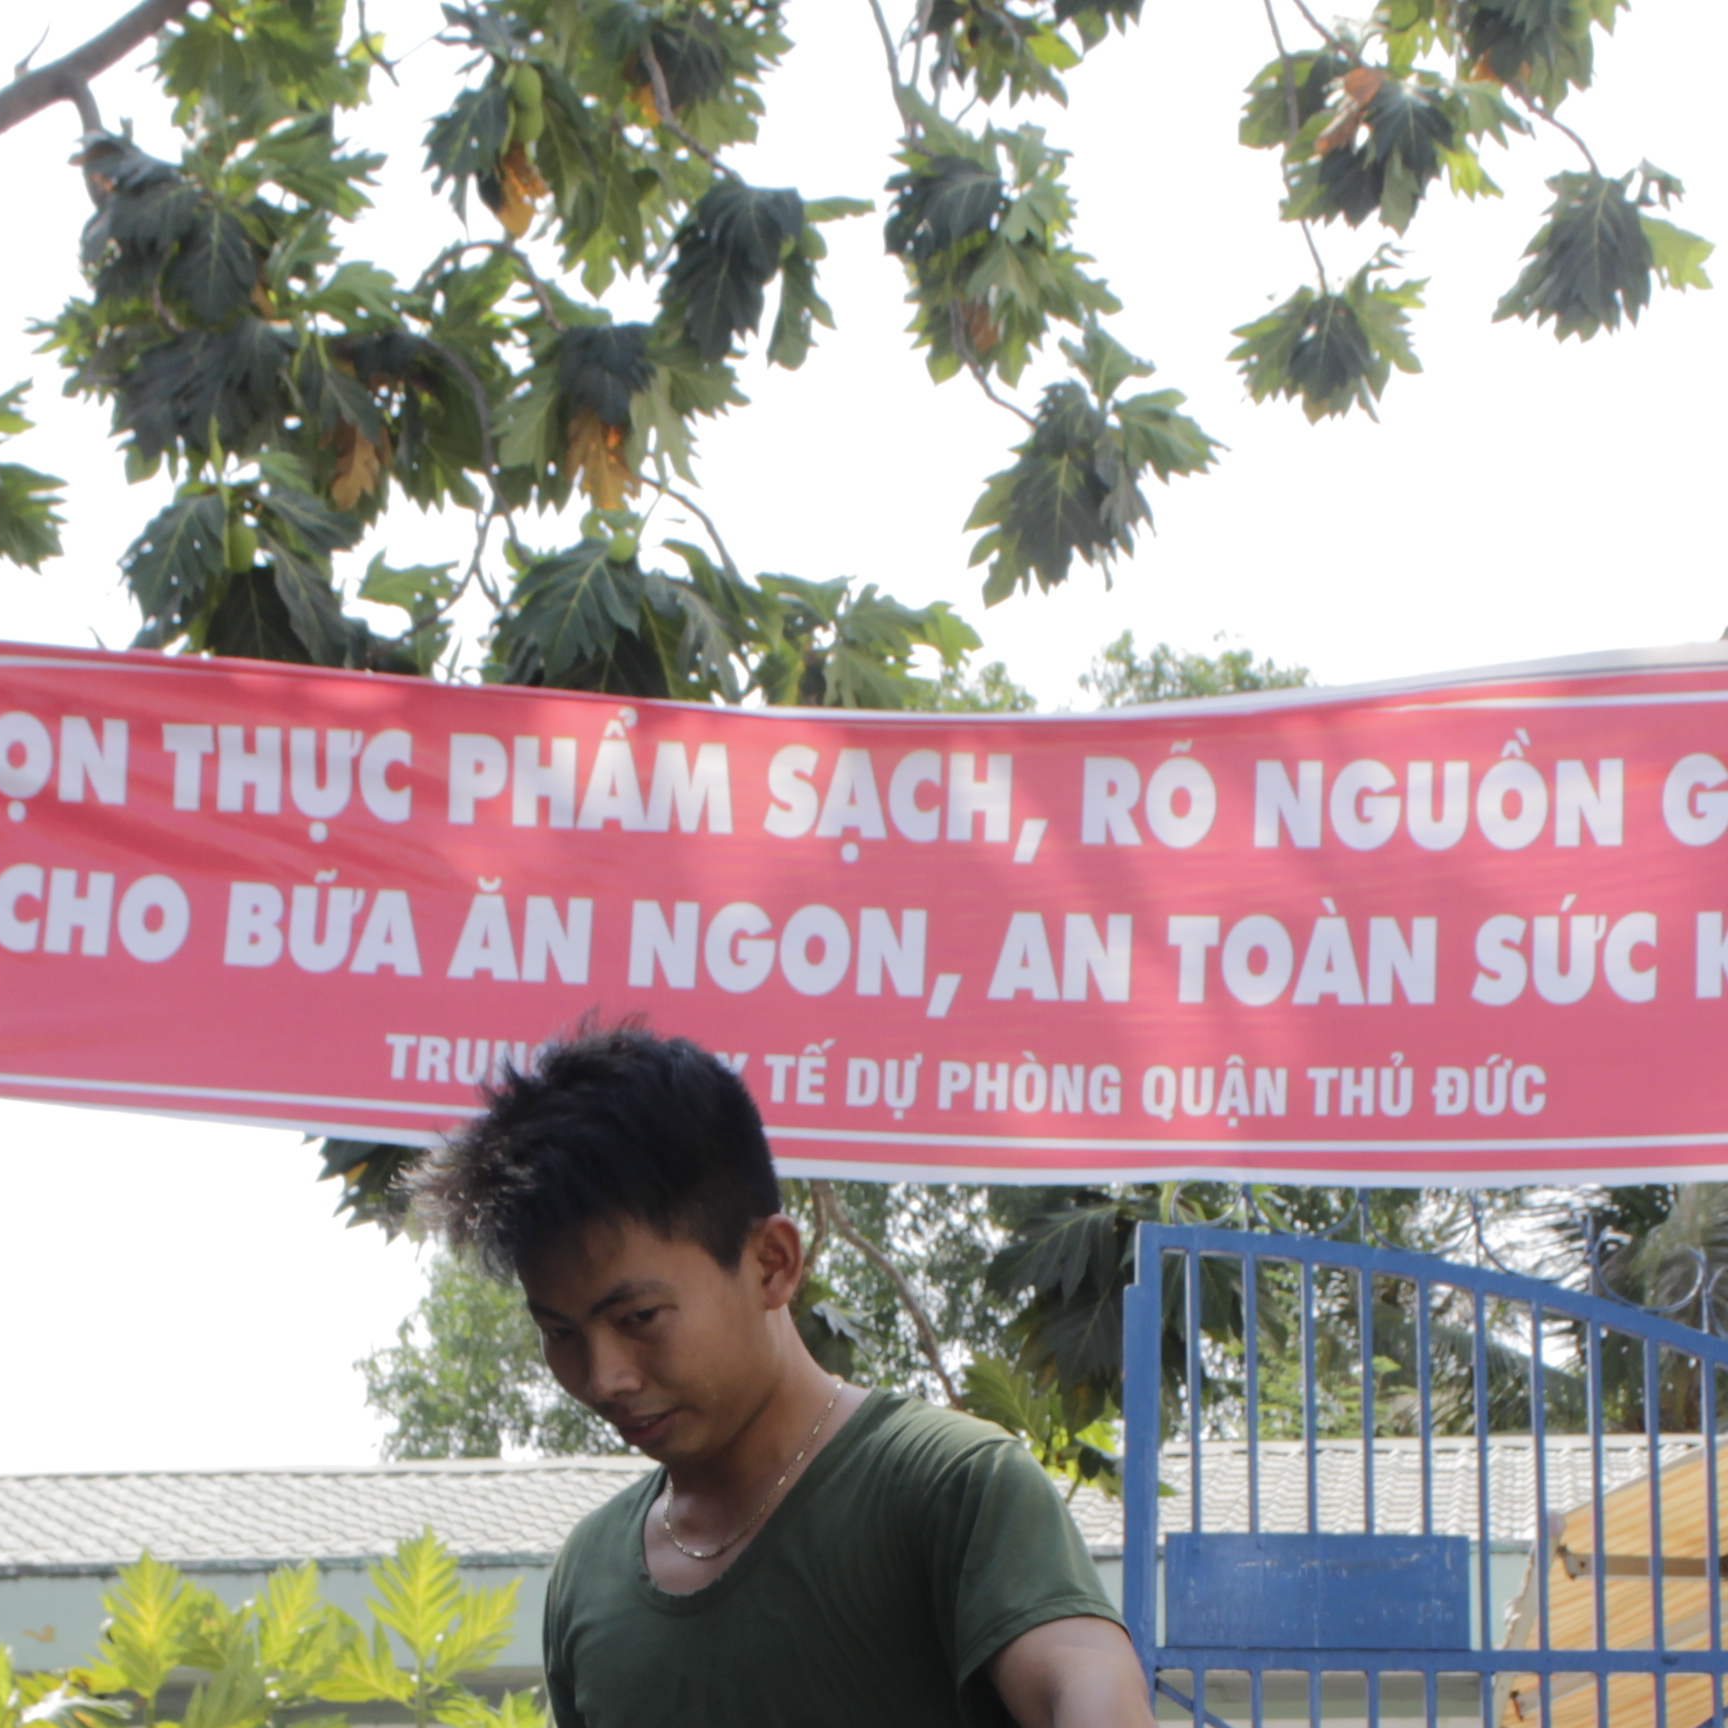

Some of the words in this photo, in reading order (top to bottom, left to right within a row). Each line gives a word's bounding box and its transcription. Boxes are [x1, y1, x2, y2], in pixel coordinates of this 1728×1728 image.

[162, 723, 412, 844] THỰC
[448, 706, 732, 836] PHẨM
[763, 745, 1049, 865] SẠCH,
[1081, 740, 1216, 849] RÕ
[1254, 727, 1624, 851] NGUỒN
[223, 868, 421, 978] BỮA
[447, 875, 593, 986] ĂN
[628, 899, 963, 1019] NGON,
[987, 911, 1132, 1005] AN
[1167, 897, 1438, 1008] TOÀN
[1470, 893, 1657, 1007] SỨC
[765, 1040, 837, 1107] TẾ
[847, 1053, 923, 1120] DỰ
[938, 1051, 1122, 1117] PHÒNG
[1142, 1054, 1288, 1128] QUẬN
[1308, 1051, 1414, 1118] THỦ
[1431, 1051, 1547, 1118] ĐỨC
